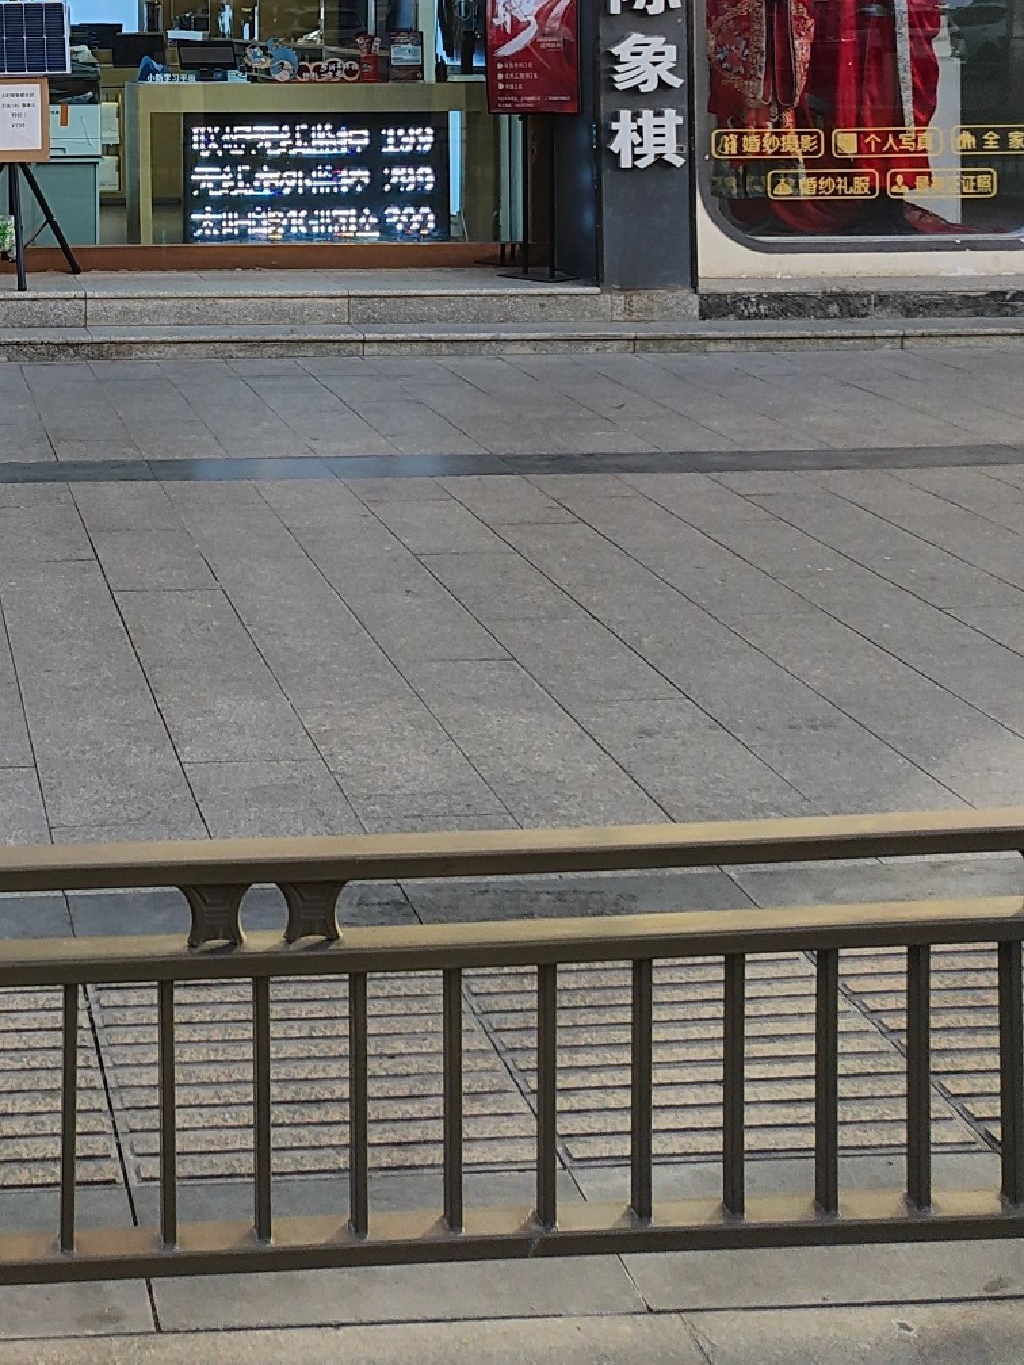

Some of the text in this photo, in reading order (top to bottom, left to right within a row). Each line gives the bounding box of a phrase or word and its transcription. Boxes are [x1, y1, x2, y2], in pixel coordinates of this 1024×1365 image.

[741, 132, 819, 155] 婚纱摄影
[863, 131, 933, 153] 个人写真
[799, 175, 872, 196] 婚纱礼服
